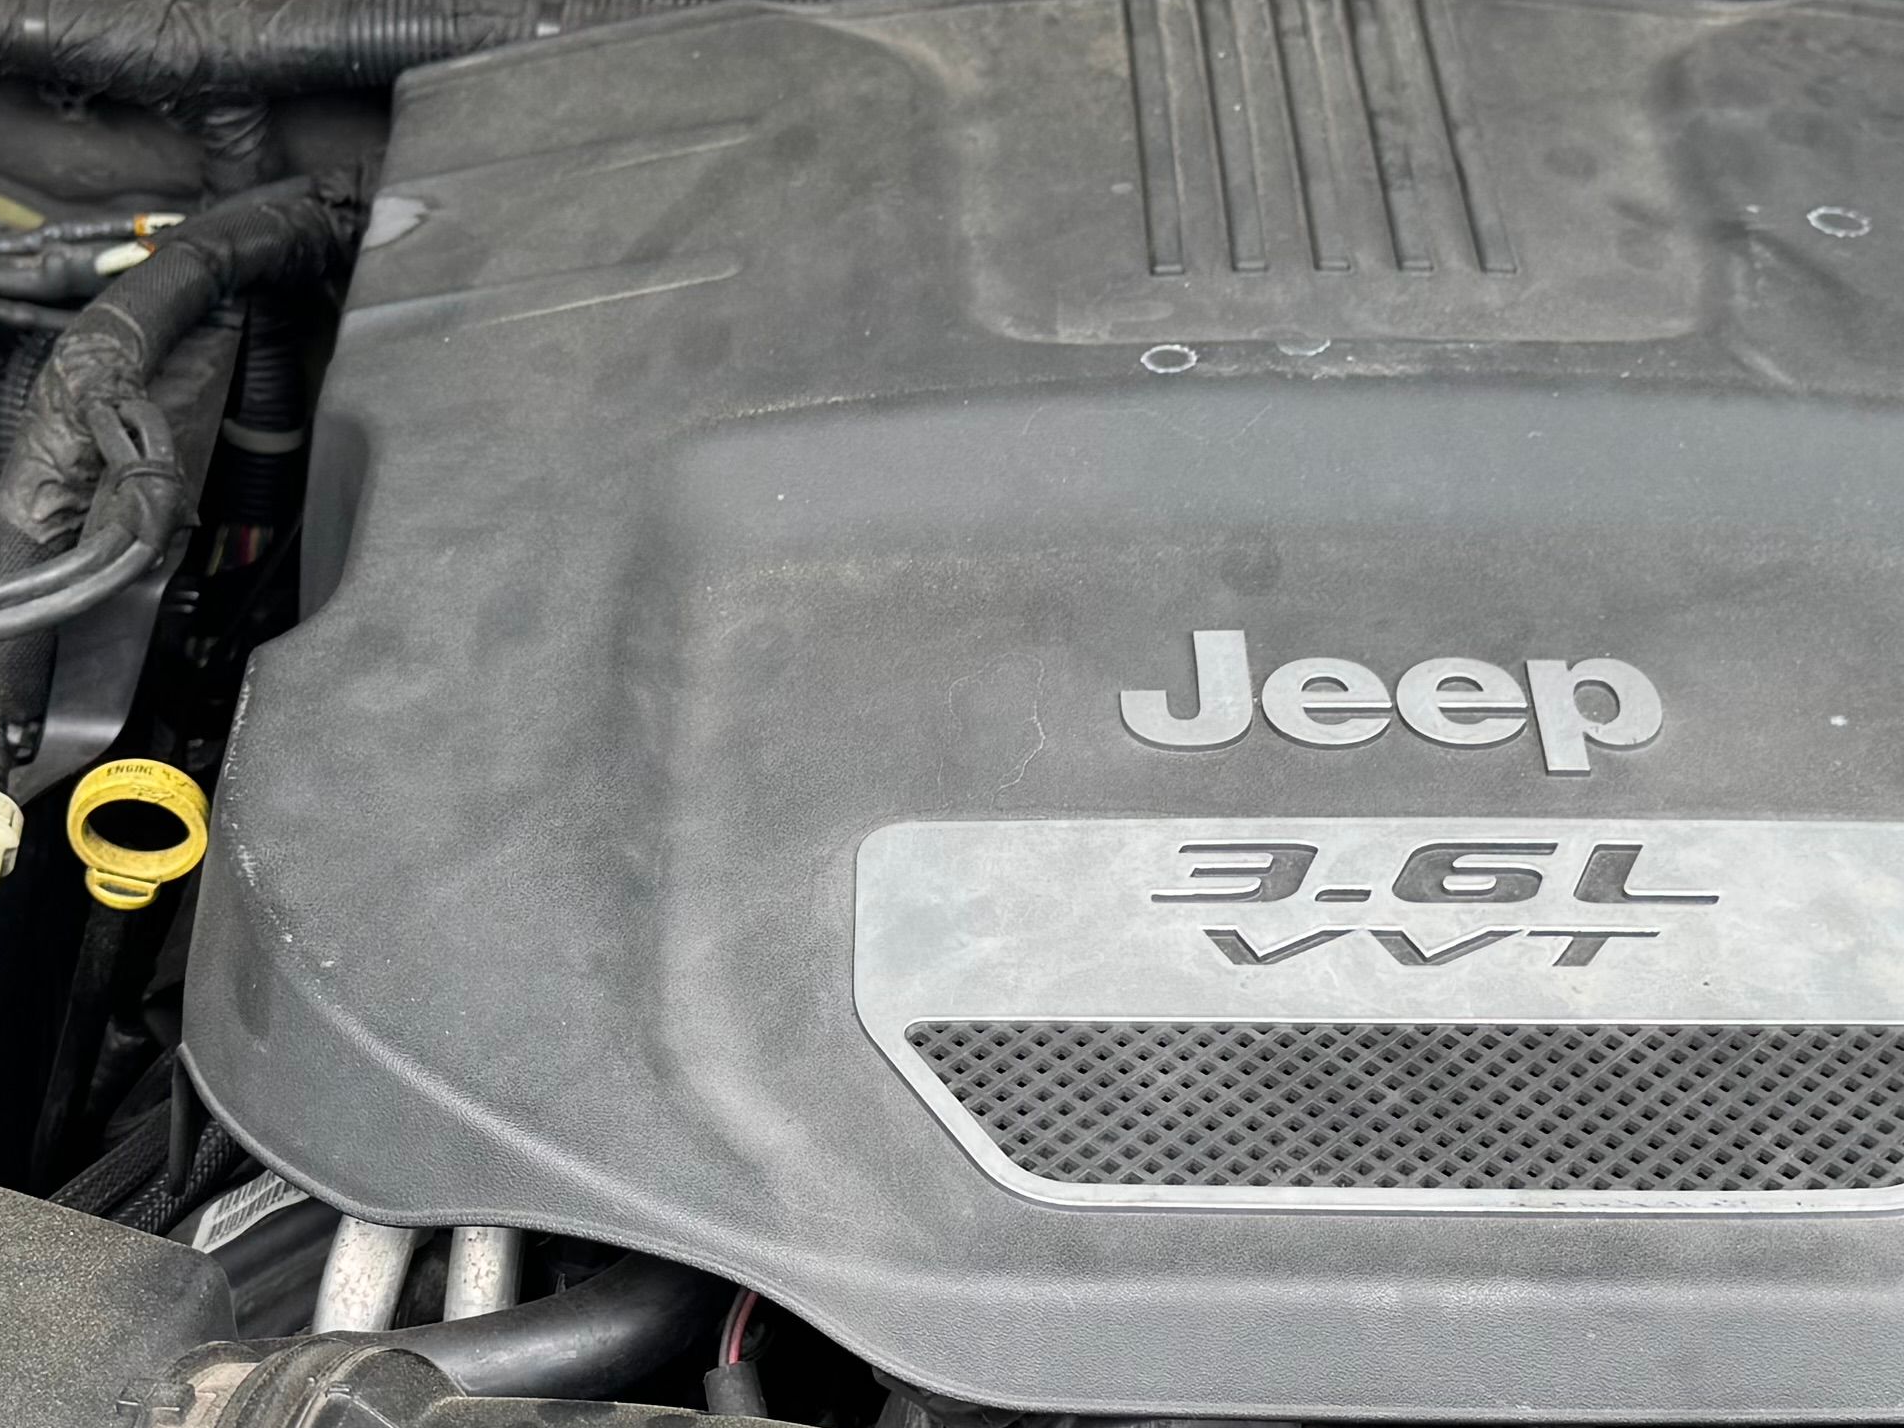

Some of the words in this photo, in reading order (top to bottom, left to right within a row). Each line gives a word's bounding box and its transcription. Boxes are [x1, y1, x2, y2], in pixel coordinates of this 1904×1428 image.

[1118, 629, 1663, 777] Jeep
[1150, 840, 1720, 905] 3.6L
[1198, 926, 1664, 969] VVT
